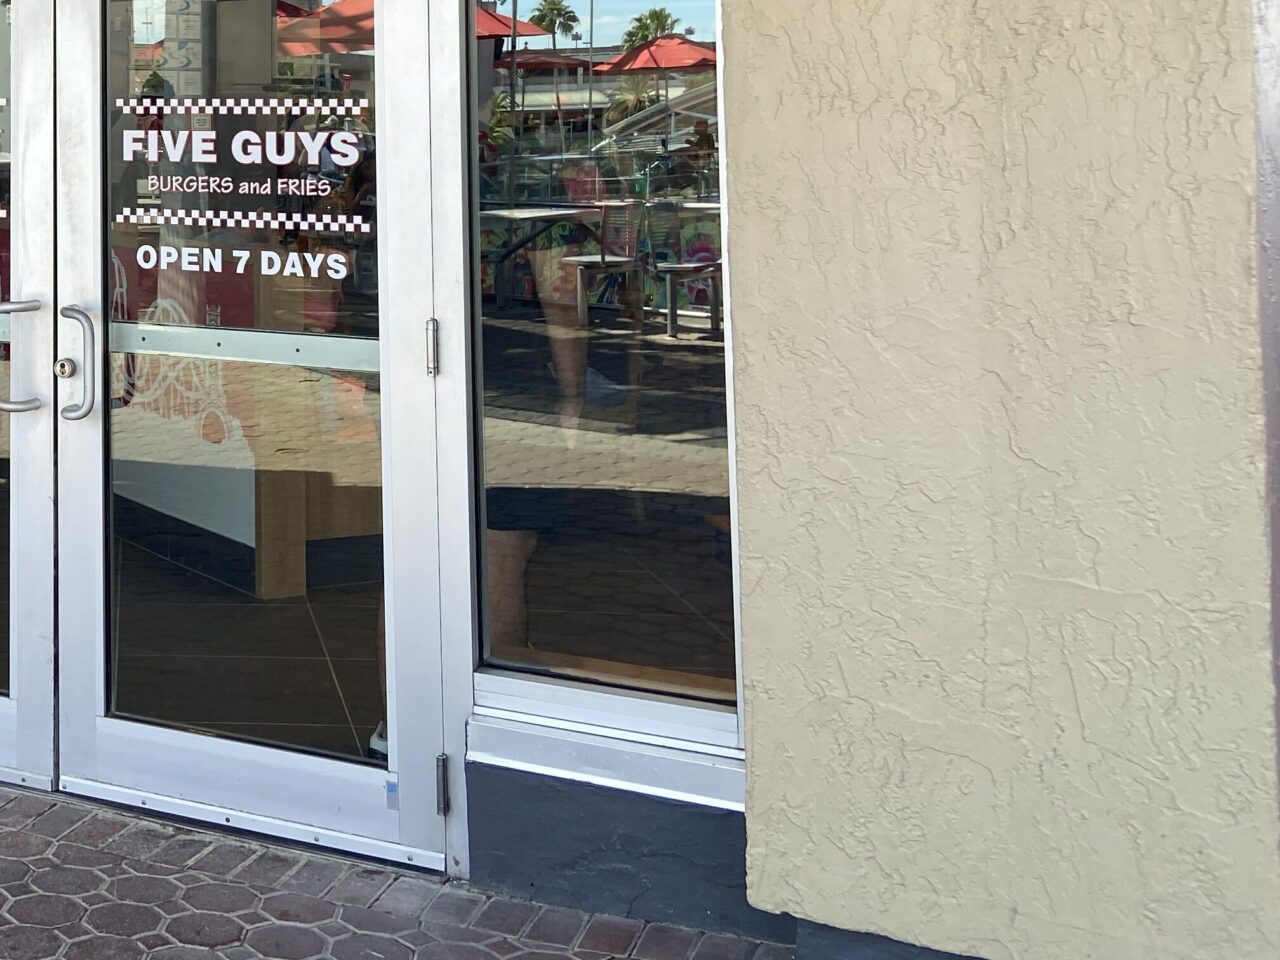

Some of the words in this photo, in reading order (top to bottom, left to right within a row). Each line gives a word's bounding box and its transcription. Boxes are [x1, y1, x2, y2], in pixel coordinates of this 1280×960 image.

[123, 129, 217, 163] FIVE
[231, 130, 360, 166] GUYS
[148, 175, 233, 193] BURGERS
[238, 178, 271, 195] and
[277, 178, 332, 197] FRIES
[136, 244, 223, 273] OPEN
[232, 250, 251, 274] 7
[261, 251, 348, 280] DAYS
